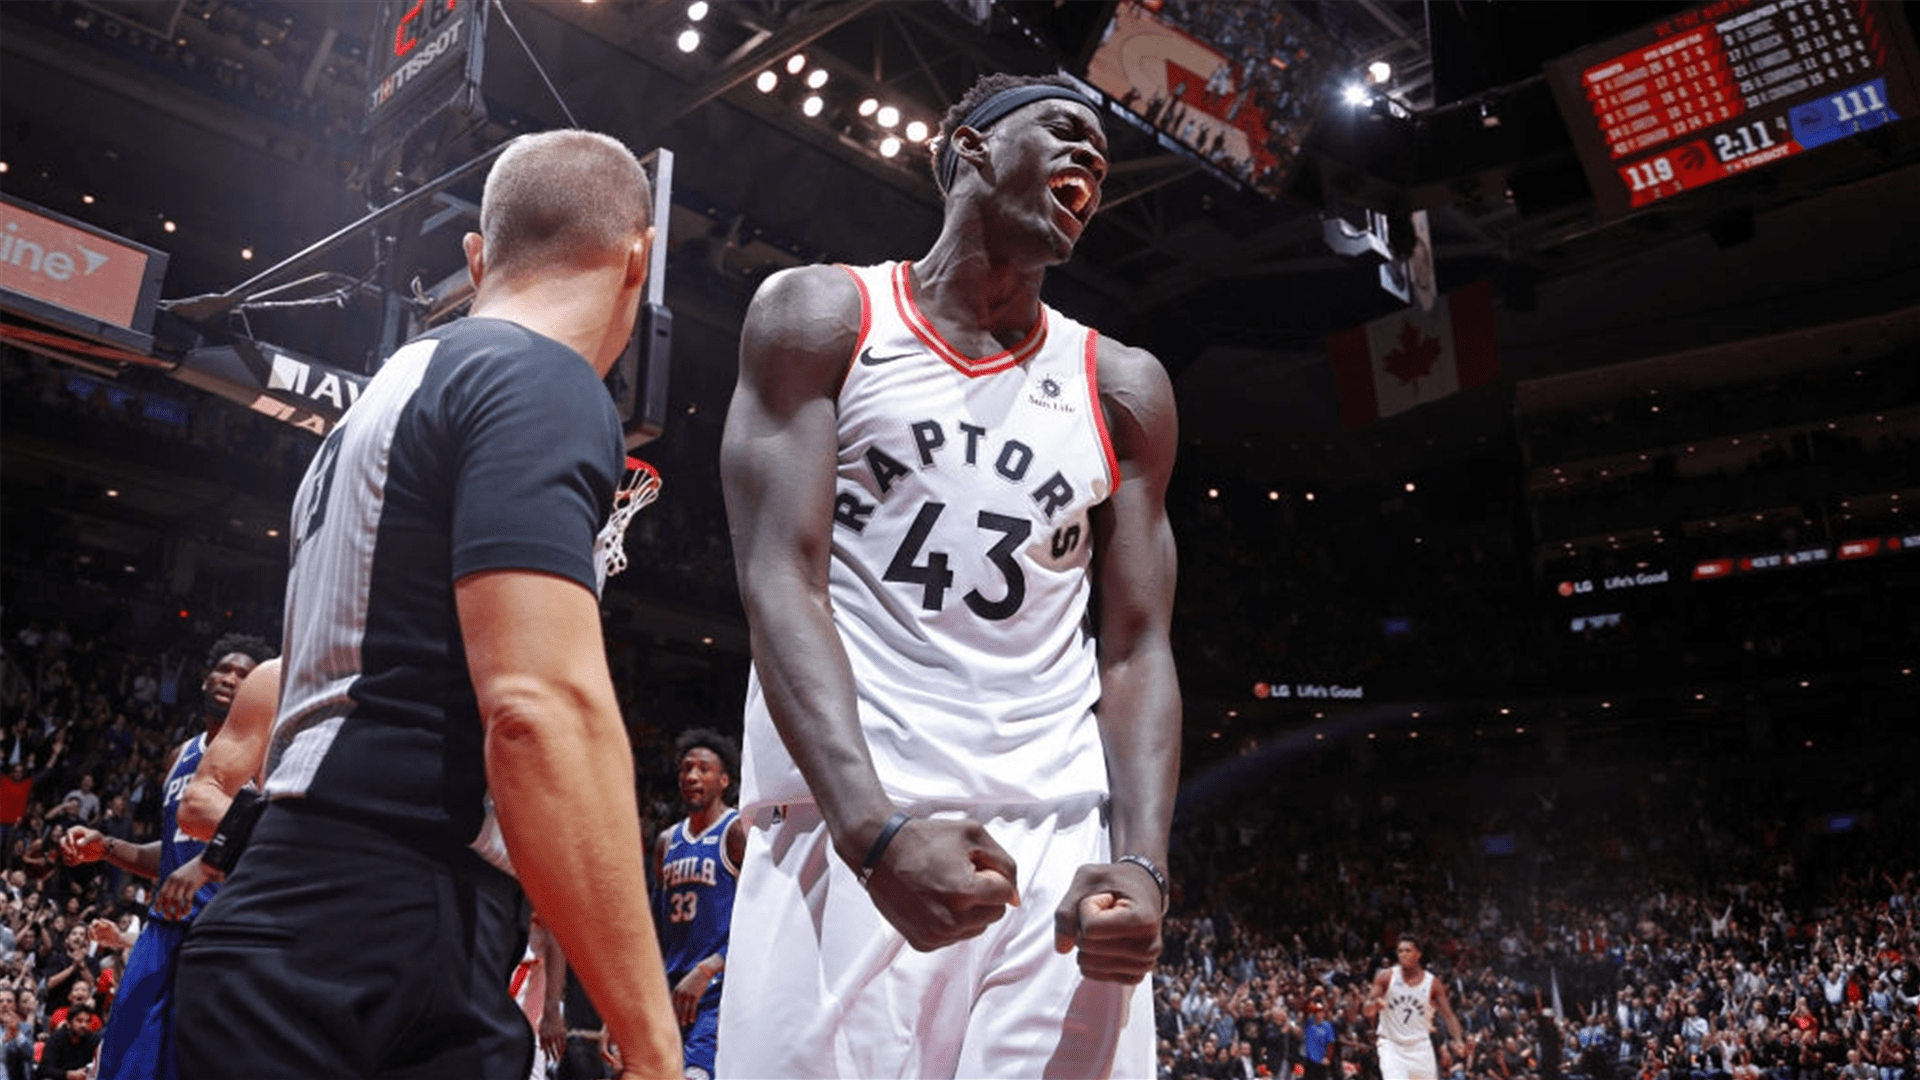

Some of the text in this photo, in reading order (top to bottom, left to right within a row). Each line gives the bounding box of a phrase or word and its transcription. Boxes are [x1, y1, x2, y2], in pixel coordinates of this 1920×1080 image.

[393, 18, 464, 89] TISSOT
[1833, 85, 1885, 121] 111
[1715, 121, 1775, 162] 2:11
[1627, 158, 1674, 190] 119
[0, 222, 75, 282] ine
[834, 420, 1080, 561] RAPTORS
[882, 502, 1032, 621] 43
[1575, 570, 1669, 593] LG Life's Good
[1271, 684, 1363, 699] LG Life's Good
[662, 856, 718, 892] PHILA
[670, 891, 697, 923] 33
[1403, 1008, 1413, 1024] 7
